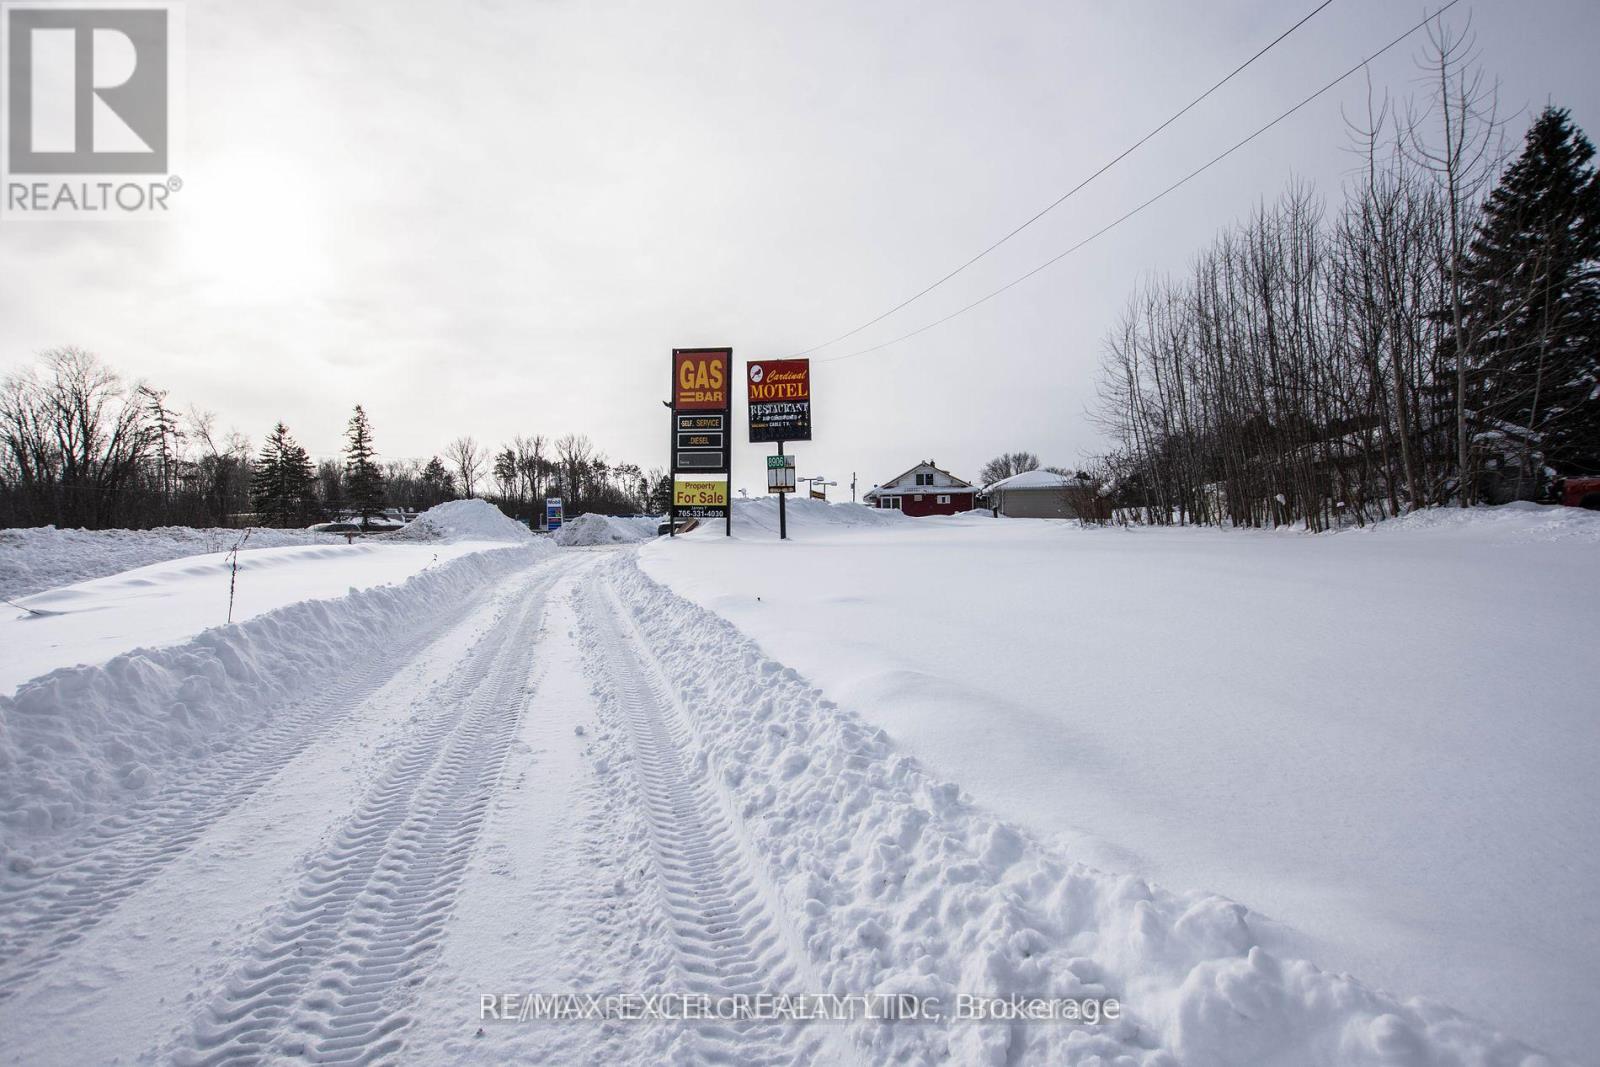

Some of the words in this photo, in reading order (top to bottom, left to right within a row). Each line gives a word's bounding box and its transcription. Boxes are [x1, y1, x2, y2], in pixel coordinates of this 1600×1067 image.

[680, 360, 723, 390] GAS
[766, 370, 807, 383] Cardinal
[695, 391, 723, 402] BAR
[750, 383, 808, 398] MOTEL
[685, 482, 715, 491] Property
[676, 491, 696, 504] For
[699, 491, 724, 504] Sale
